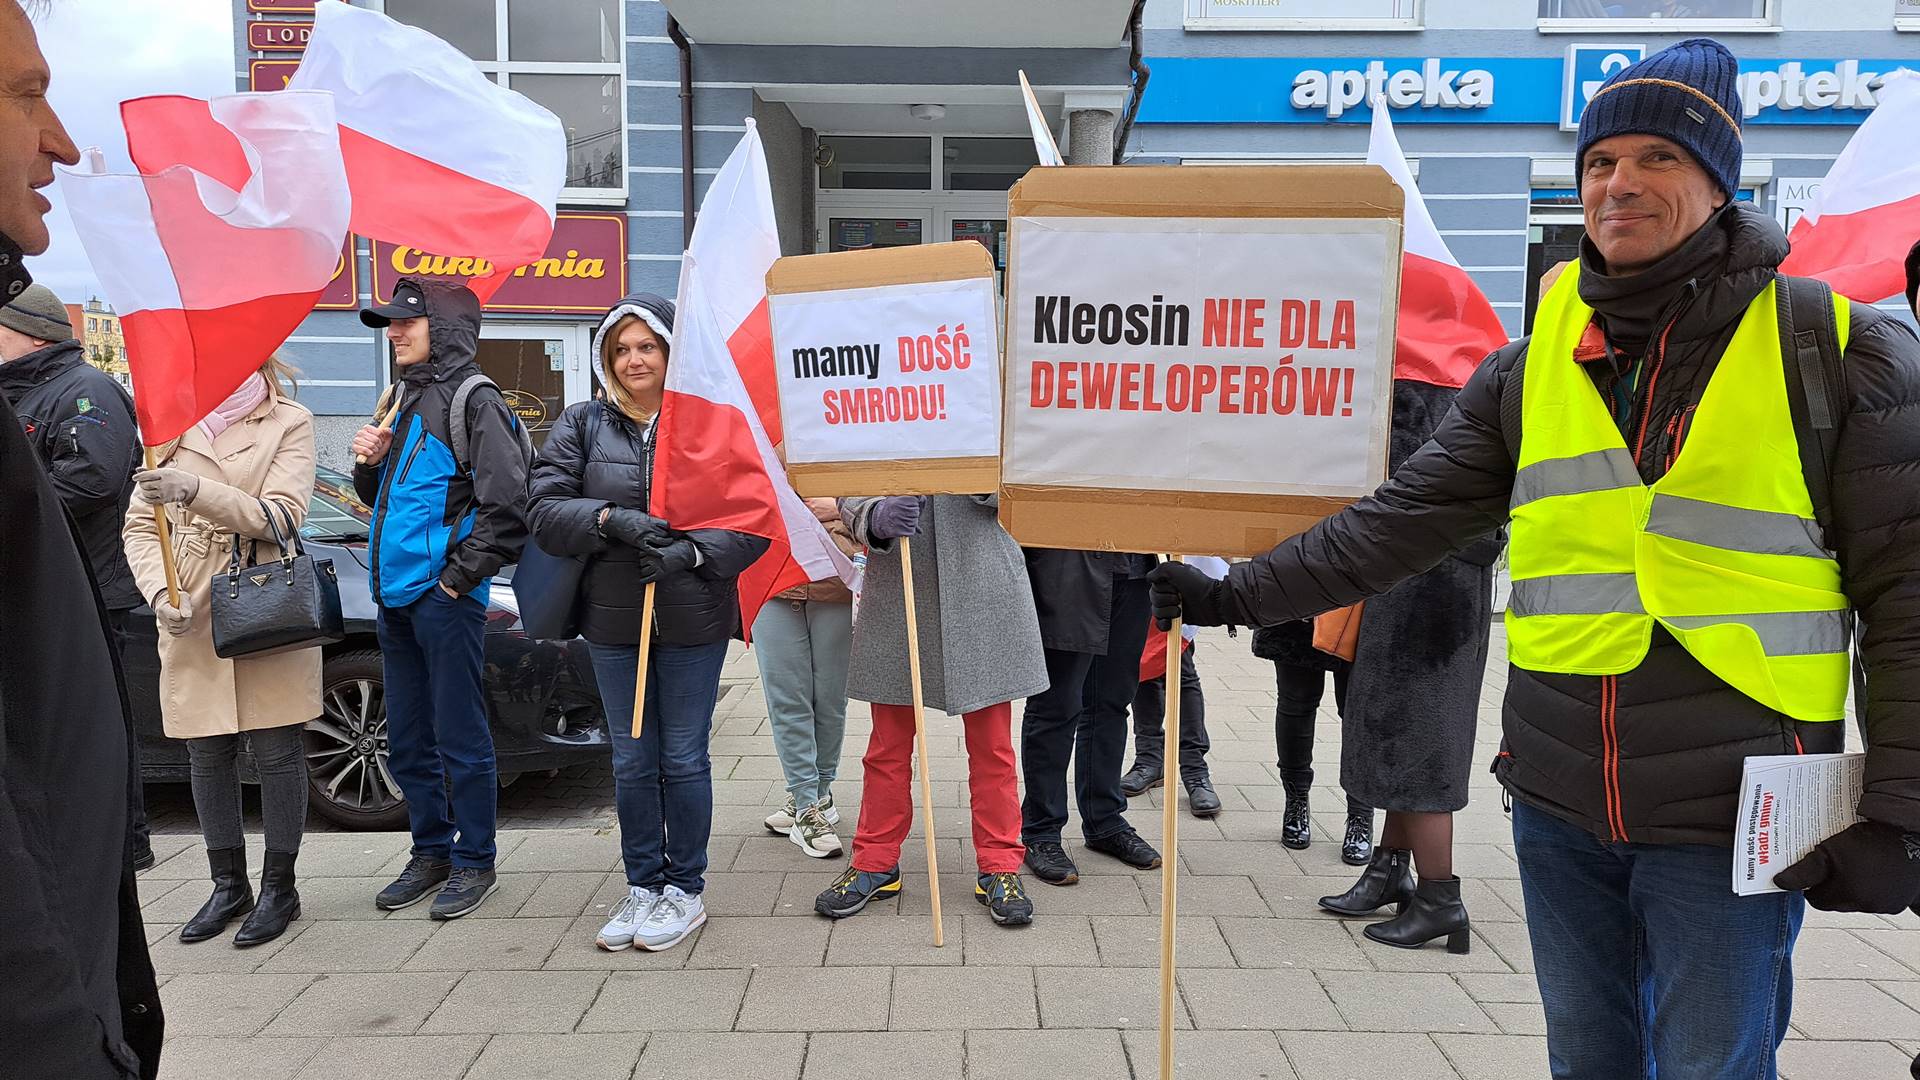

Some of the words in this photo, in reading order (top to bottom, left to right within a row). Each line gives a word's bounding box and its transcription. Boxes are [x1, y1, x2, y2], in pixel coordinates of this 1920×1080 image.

[266, 28, 311, 42] LOD
[1290, 58, 1494, 118] apteka
[1737, 60, 1884, 118] ptek
[391, 245, 605, 278] Cukirnia
[1033, 295, 1190, 347] Kleosin
[1202, 298, 1266, 348] NIE
[1279, 299, 1357, 350] DLA
[792, 343, 881, 380] mamy
[897, 323, 972, 373] DOŚĆ
[822, 383, 947, 425] SMRODU!
[1030, 353, 1356, 417] DEWELOPERÓW!
[1748, 783, 1762, 835] postępowania
[1759, 791, 1774, 828] gminy!
[1746, 836, 1755, 855] dość
[1757, 830, 1769, 865] władz
[1747, 857, 1756, 881] Mamy
